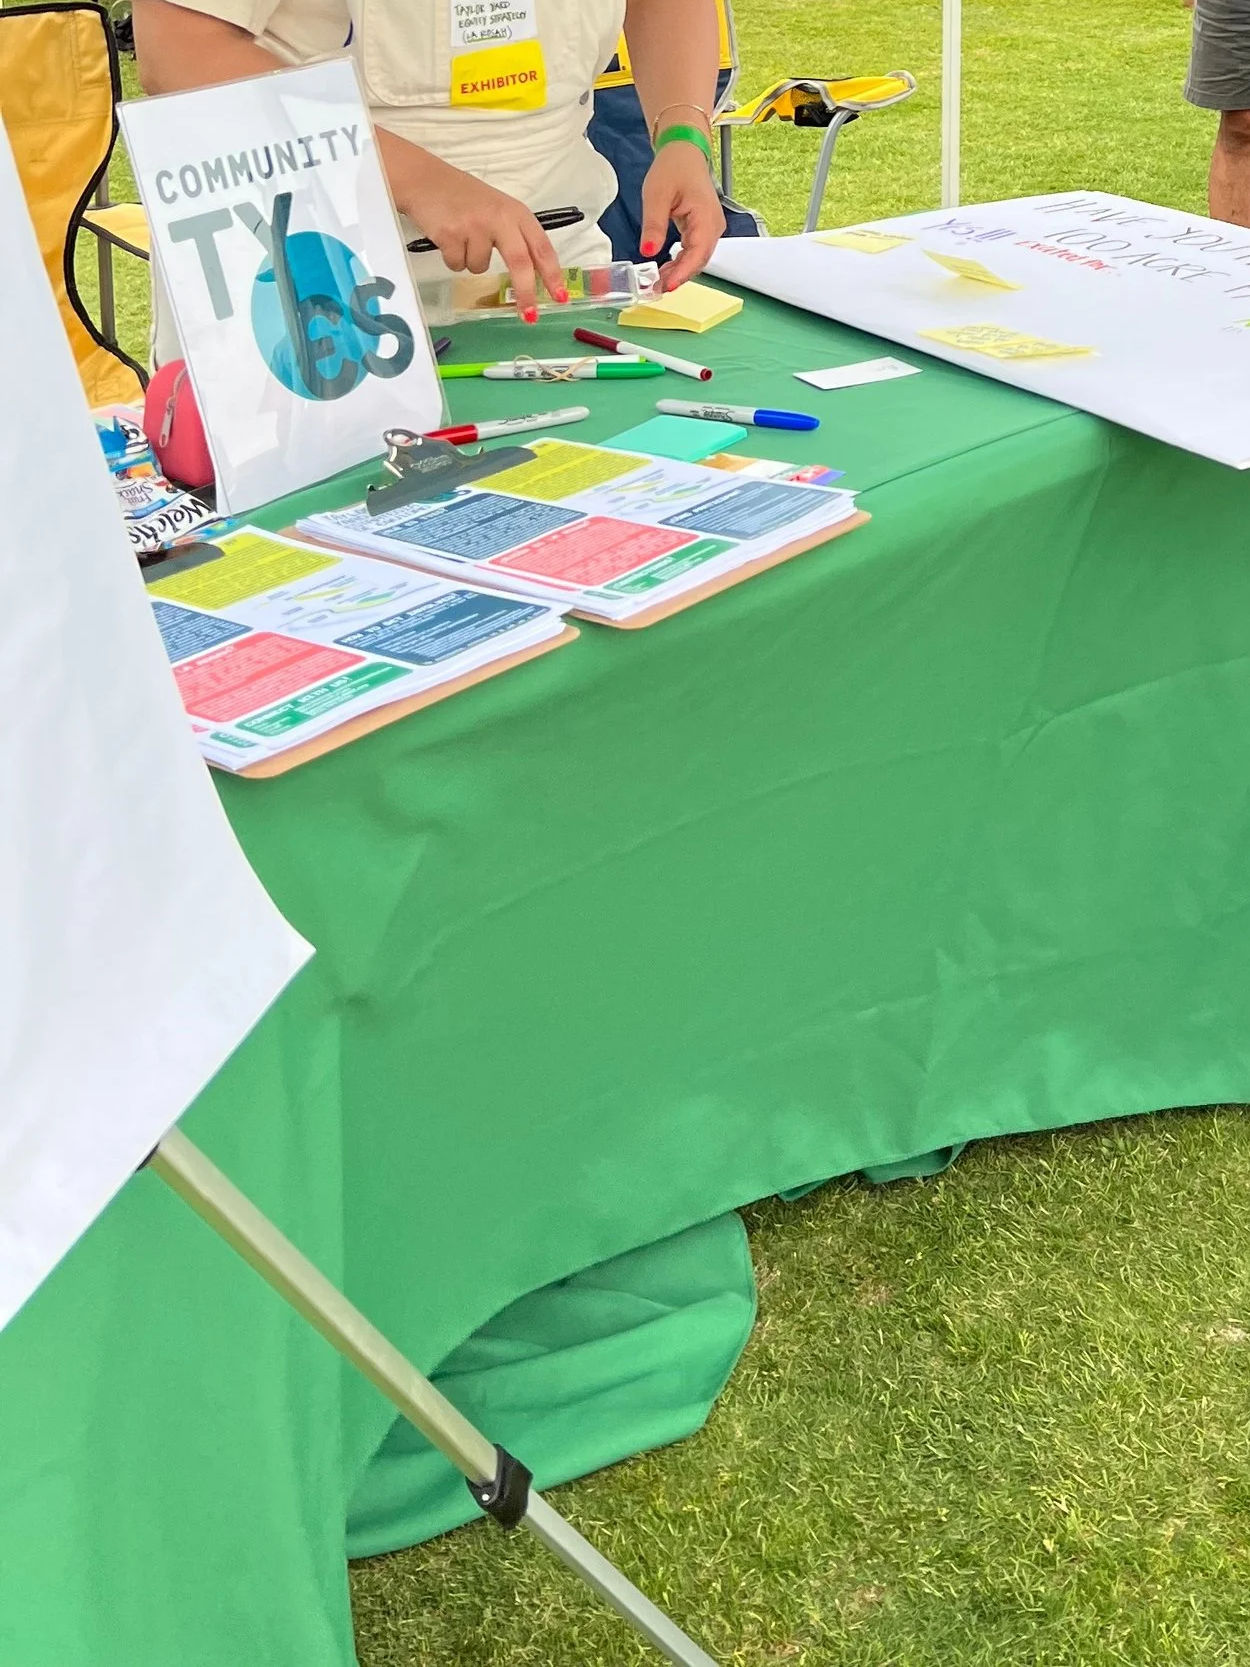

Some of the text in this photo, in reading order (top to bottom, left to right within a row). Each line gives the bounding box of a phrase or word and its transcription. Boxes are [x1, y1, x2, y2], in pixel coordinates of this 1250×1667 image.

[460, 70, 539, 95] EXHIBITOR
[155, 124, 359, 204] COMMUNITY
[1034, 199, 1168, 226] HAVE
[1044, 228, 1132, 252] 100
[1111, 253, 1232, 283] ACRE
